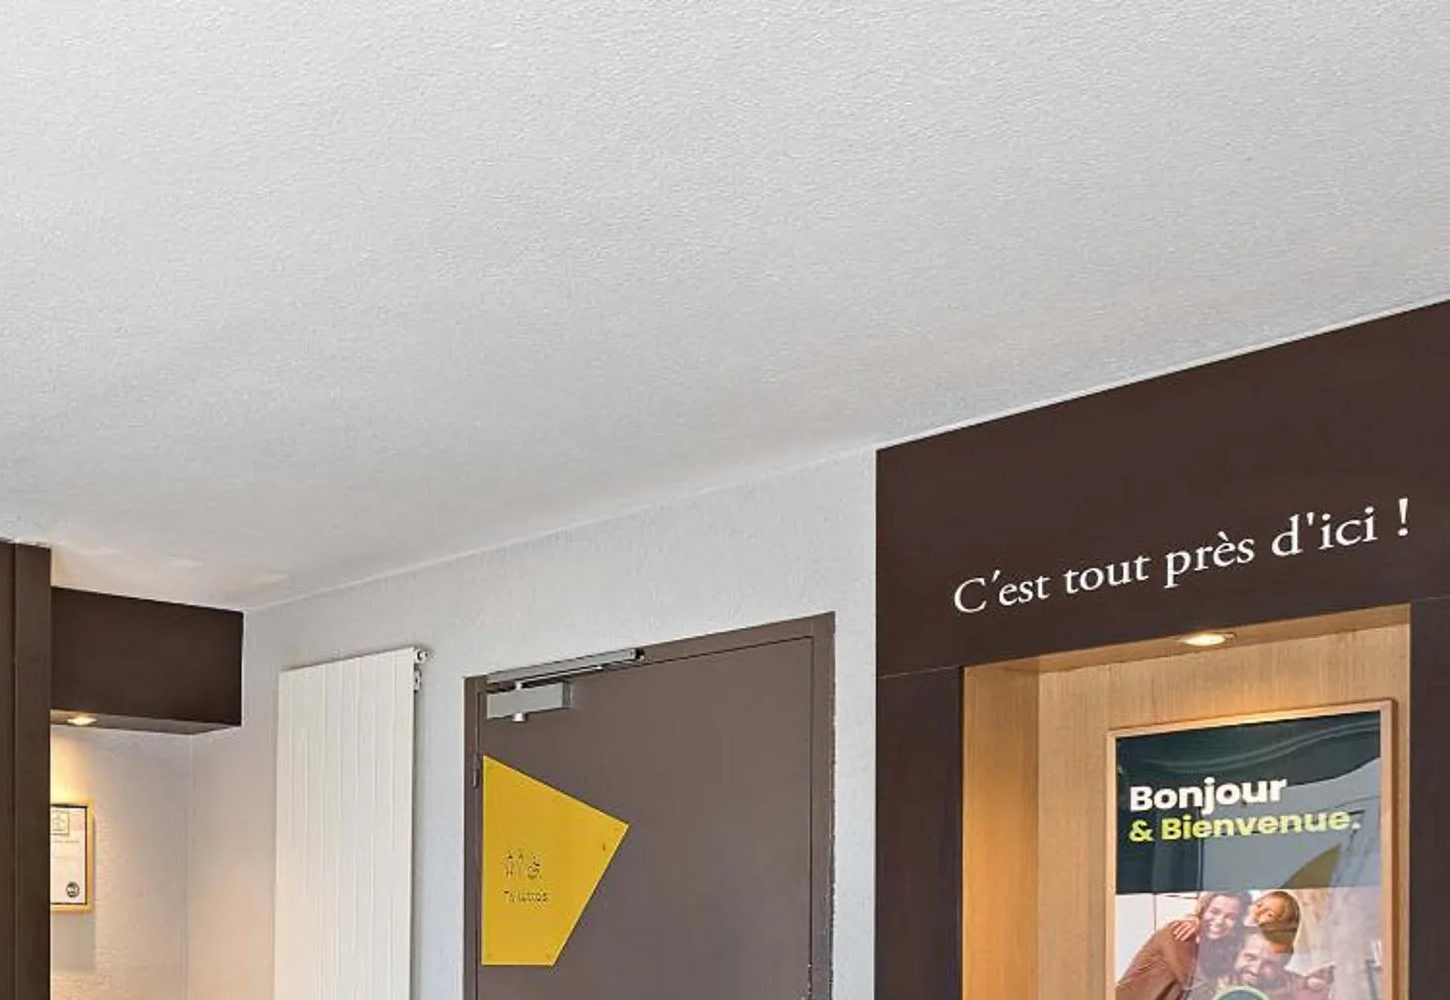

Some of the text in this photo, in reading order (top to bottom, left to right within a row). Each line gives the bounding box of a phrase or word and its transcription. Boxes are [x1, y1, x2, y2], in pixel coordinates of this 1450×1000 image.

[953, 498, 1410, 614] C'est tout près d'ici !
[1129, 776, 1288, 815] Bonjour
[1128, 819, 1153, 842] &
